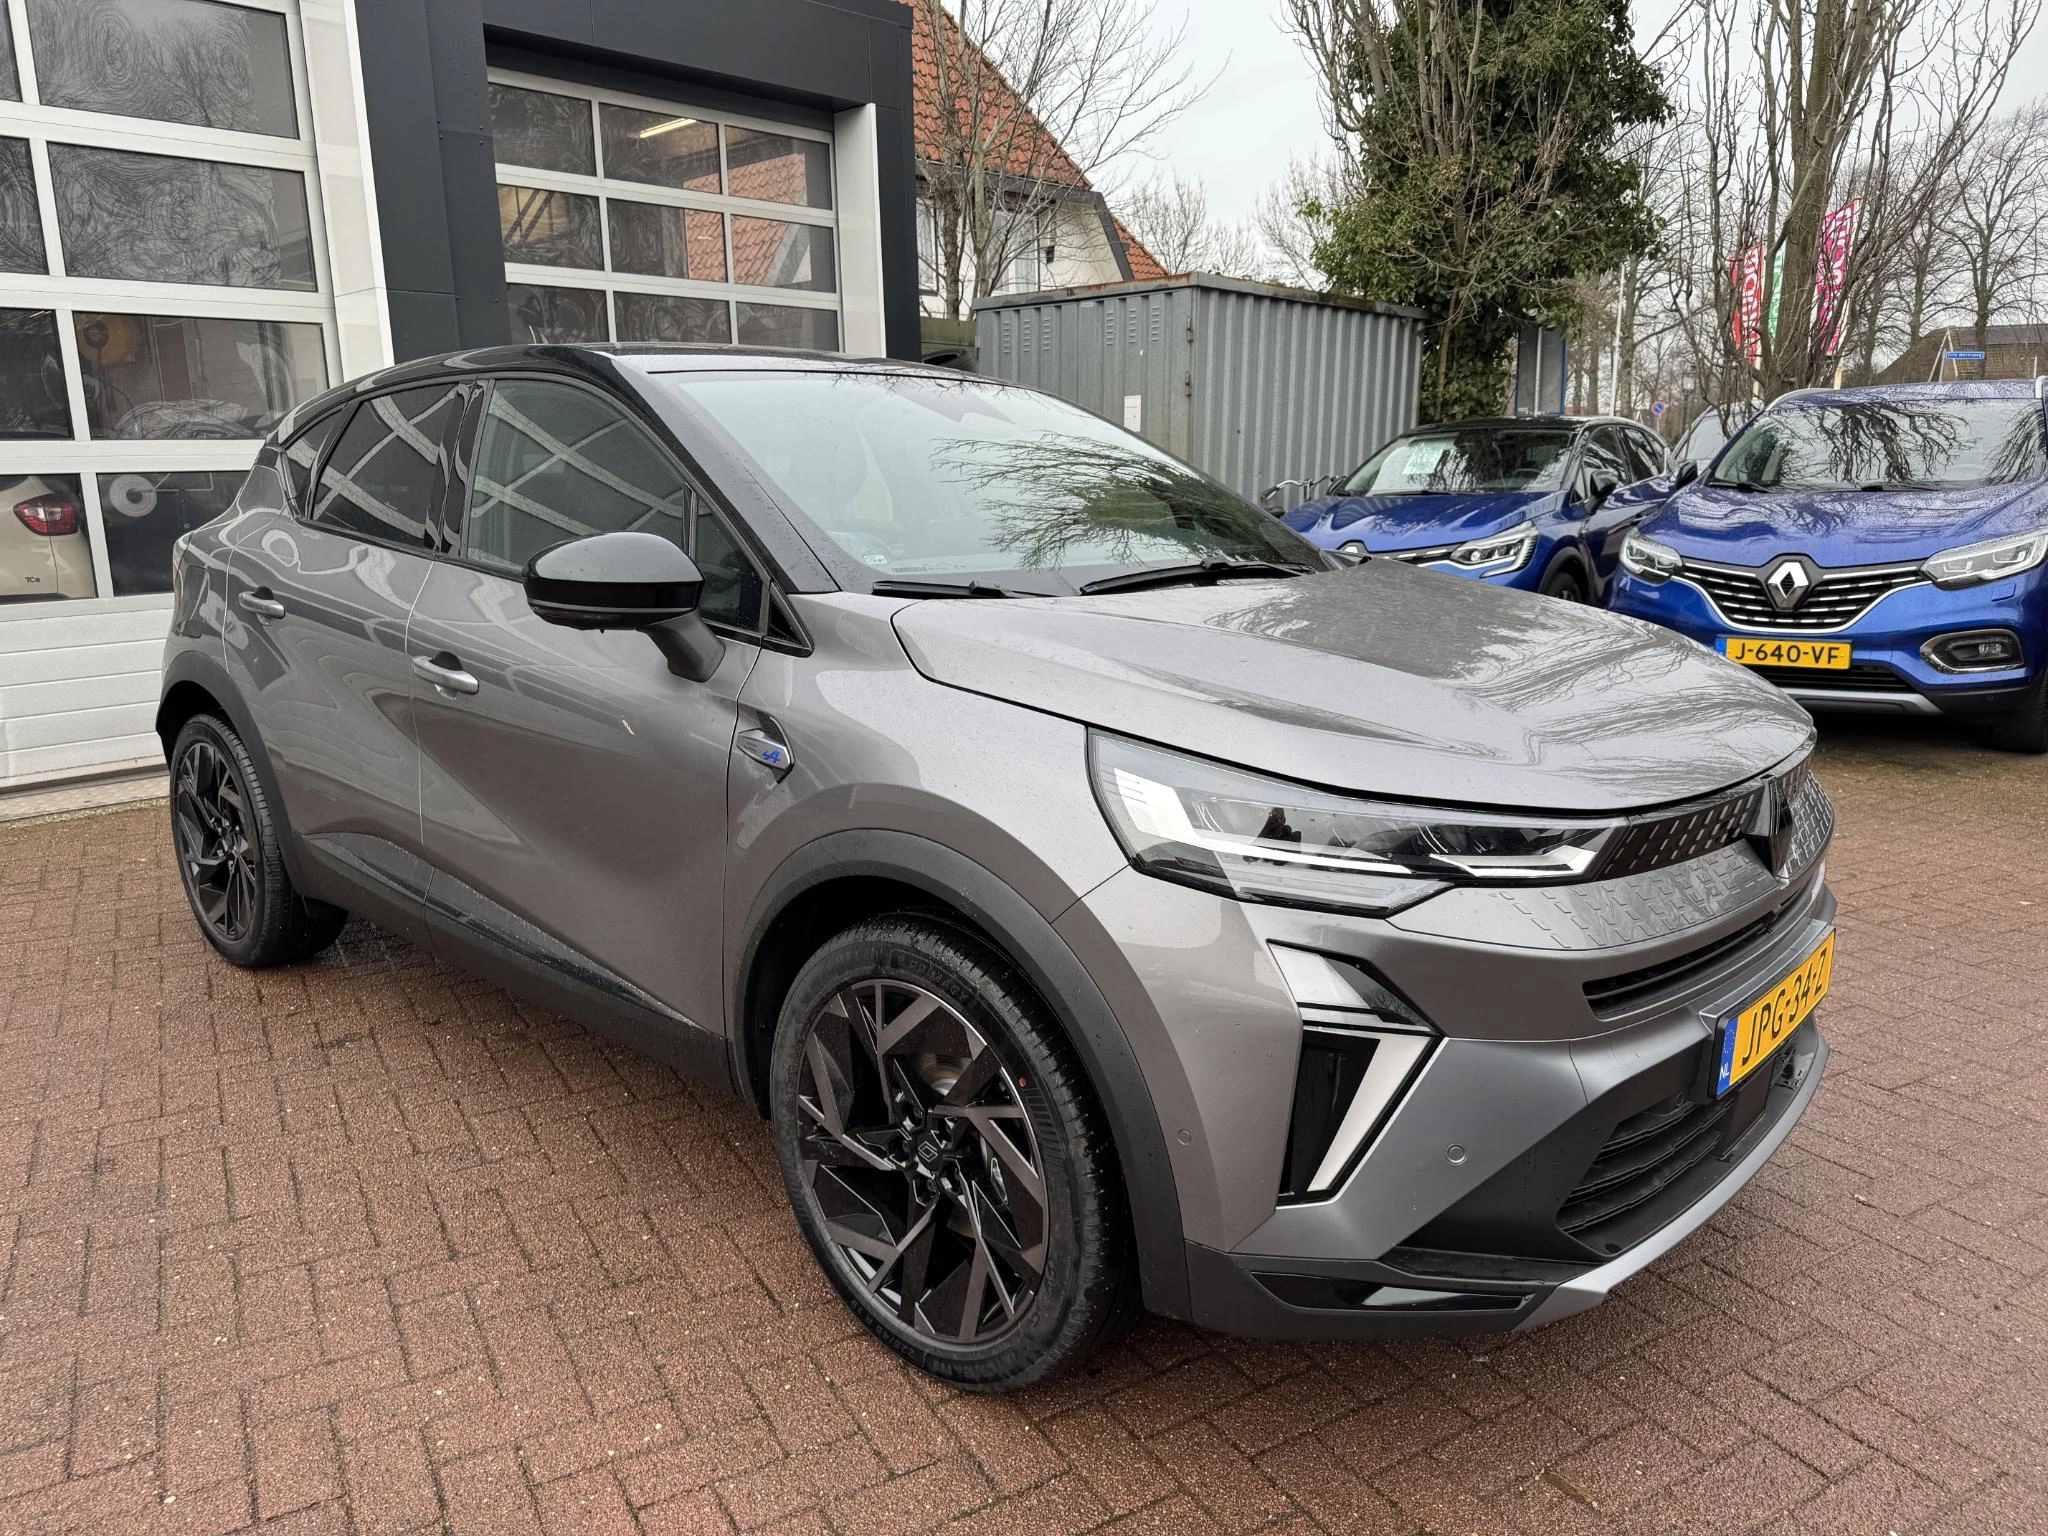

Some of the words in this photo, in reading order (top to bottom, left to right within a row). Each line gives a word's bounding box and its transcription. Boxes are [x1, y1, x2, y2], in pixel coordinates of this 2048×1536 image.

[1735, 643, 1840, 665] J-640-VF
[1741, 948, 1827, 1067] JPG-34-Z
[1719, 1062, 1730, 1082] NL
